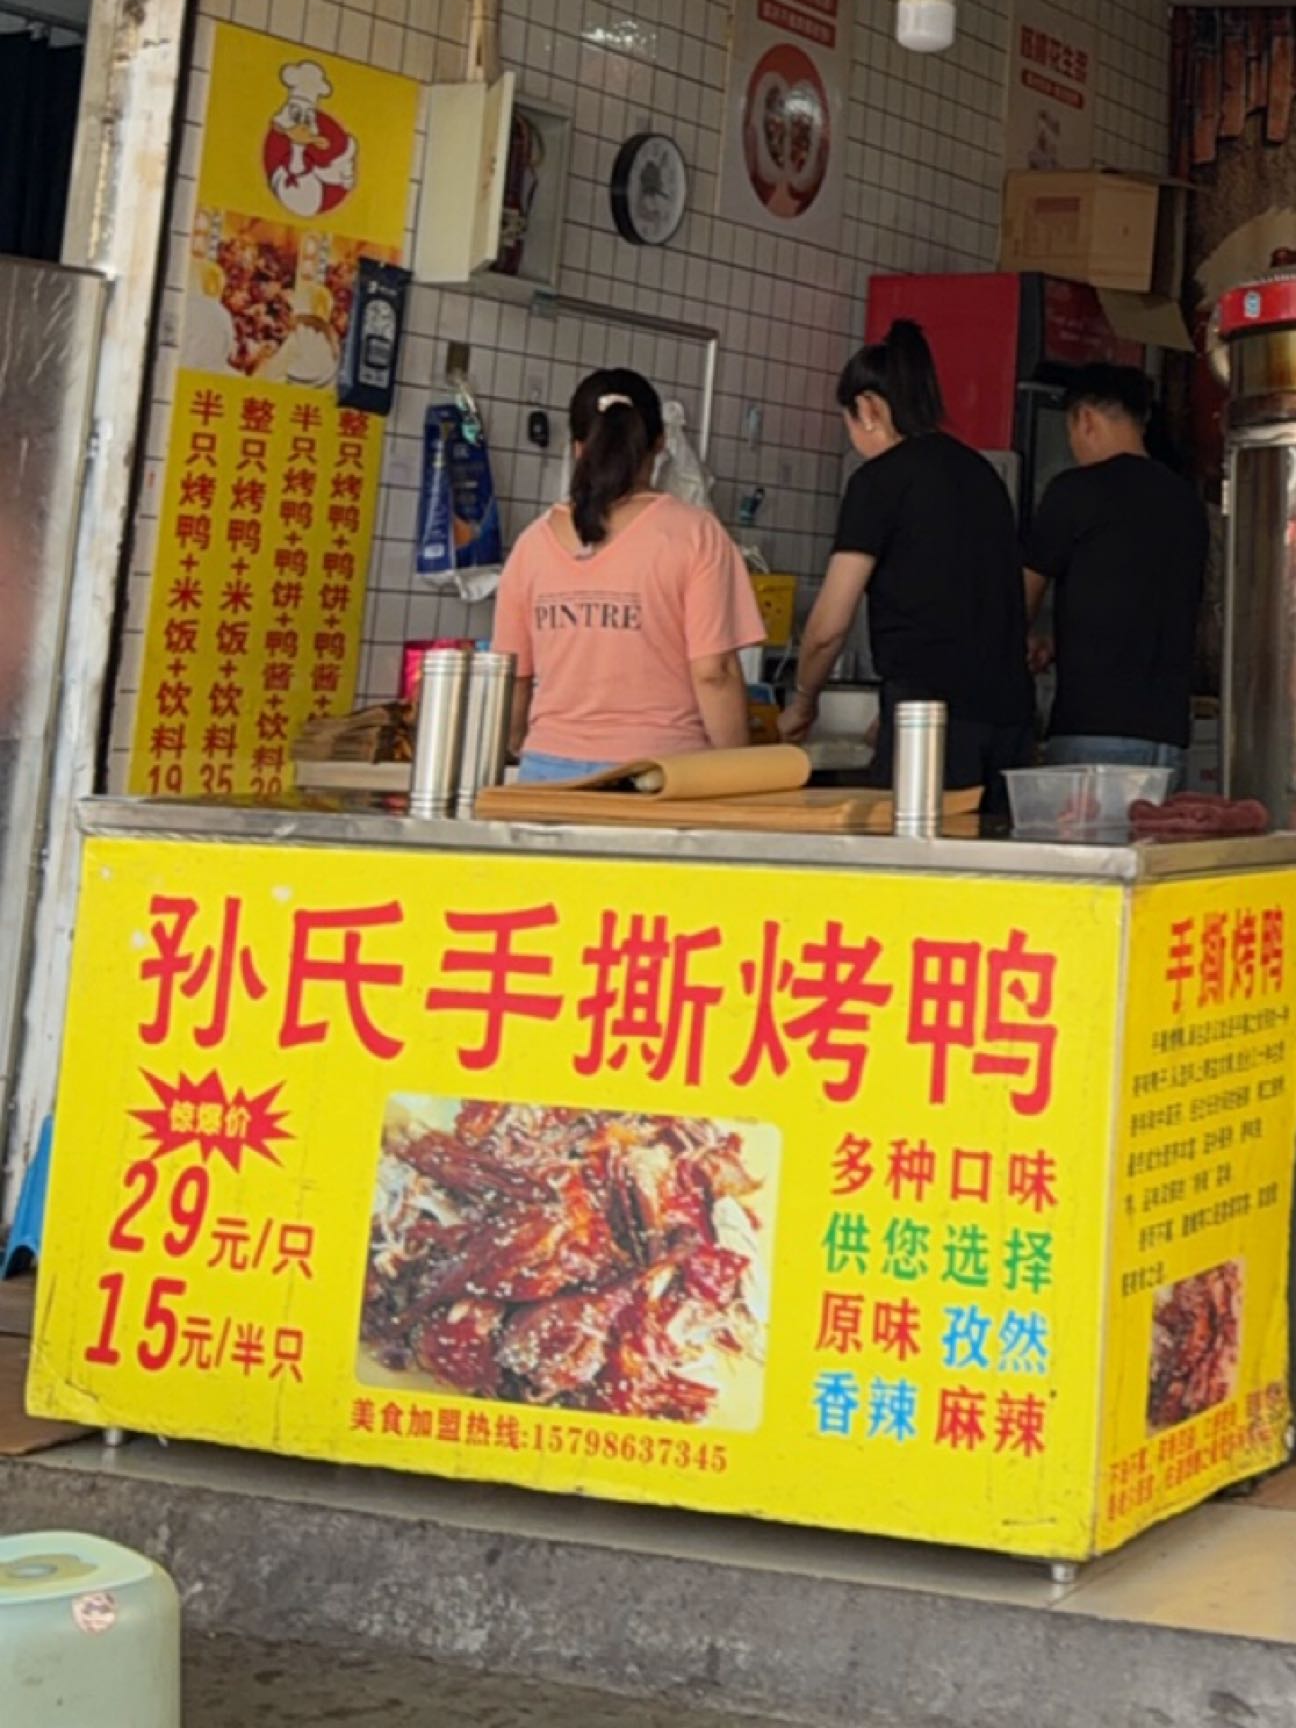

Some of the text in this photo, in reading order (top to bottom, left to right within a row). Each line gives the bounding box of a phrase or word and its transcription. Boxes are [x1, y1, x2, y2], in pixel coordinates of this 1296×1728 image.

[138, 893, 1058, 1116] 孙氏手撕烤鸭
[1165, 906, 1285, 1013] 手撕烤鸭
[109, 1159, 315, 1279] 29元/只
[830, 1132, 1058, 1212] 多种口味
[822, 1212, 1053, 1294] 供您选择
[84, 1272, 303, 1383] 15元/半只
[815, 1291, 1048, 1374] 原味 孜然
[812, 1373, 917, 1442] 香辣
[934, 1384, 1048, 1459] 麻辣
